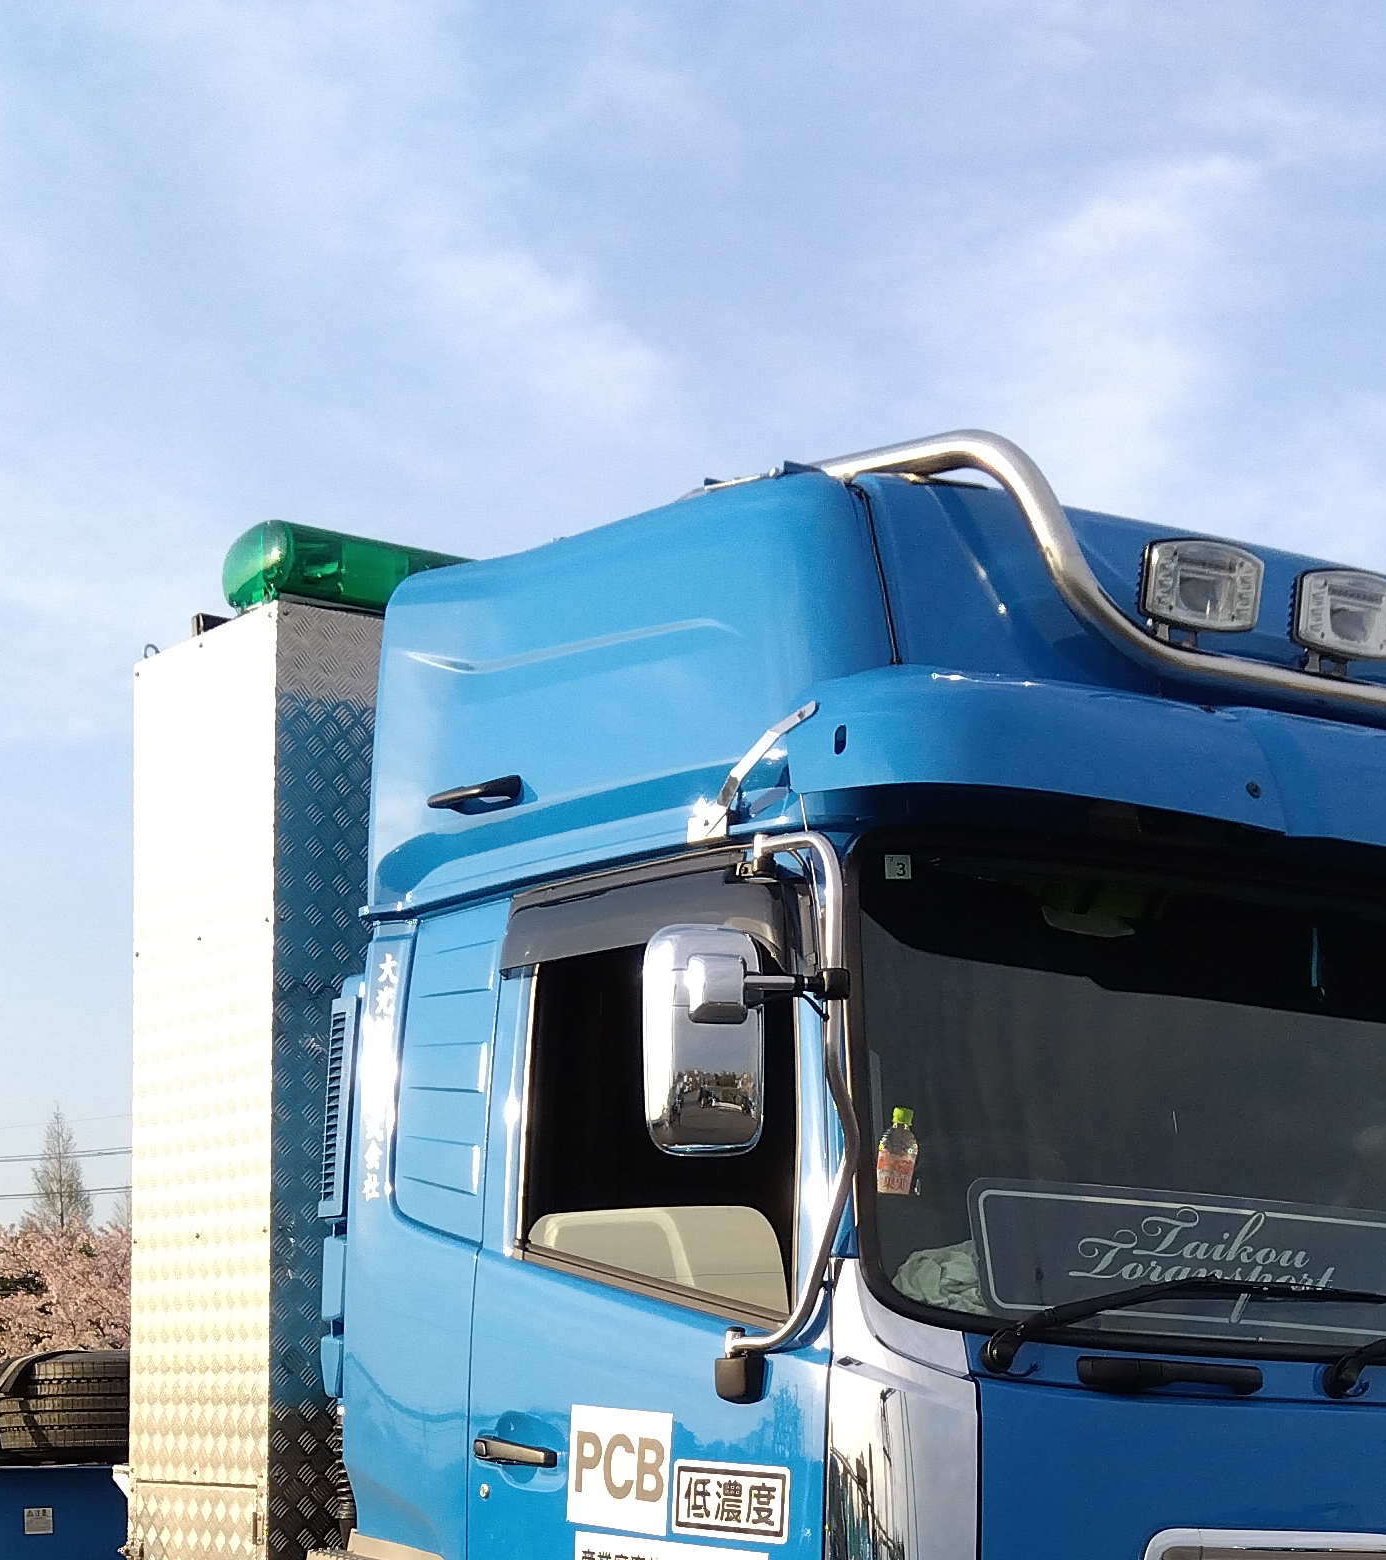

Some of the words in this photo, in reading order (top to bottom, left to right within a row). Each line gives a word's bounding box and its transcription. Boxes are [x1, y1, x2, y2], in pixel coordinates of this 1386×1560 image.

[896, 862, 906, 877] 3
[1132, 1206, 1311, 1268] Taikou
[574, 1430, 664, 1503] PCB
[684, 1476, 777, 1528] 低濃度
